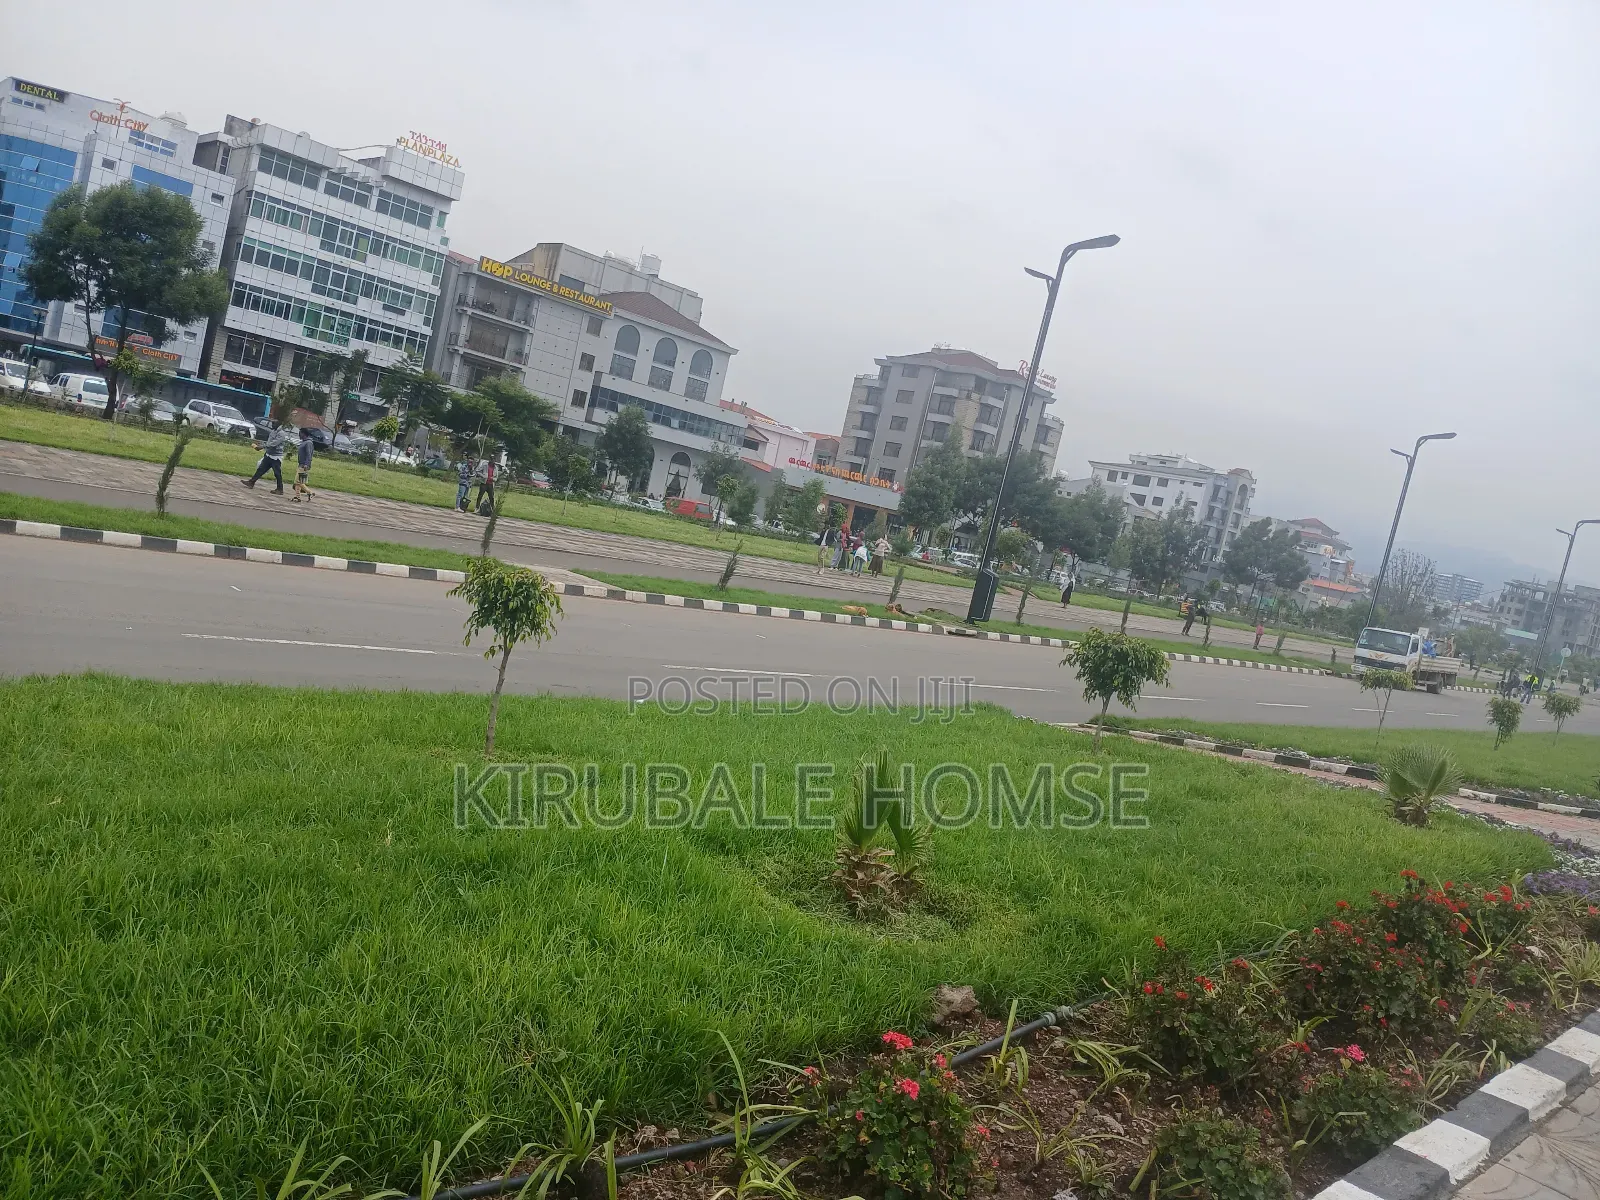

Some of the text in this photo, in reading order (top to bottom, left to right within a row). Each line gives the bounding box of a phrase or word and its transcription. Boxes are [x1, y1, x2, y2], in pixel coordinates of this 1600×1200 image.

[20, 82, 59, 101] DENTAL
[89, 109, 121, 126] Cloth
[481, 257, 613, 312] HOP LOUNGE & RESTAURANT
[142, 348, 162, 359] Cloth
